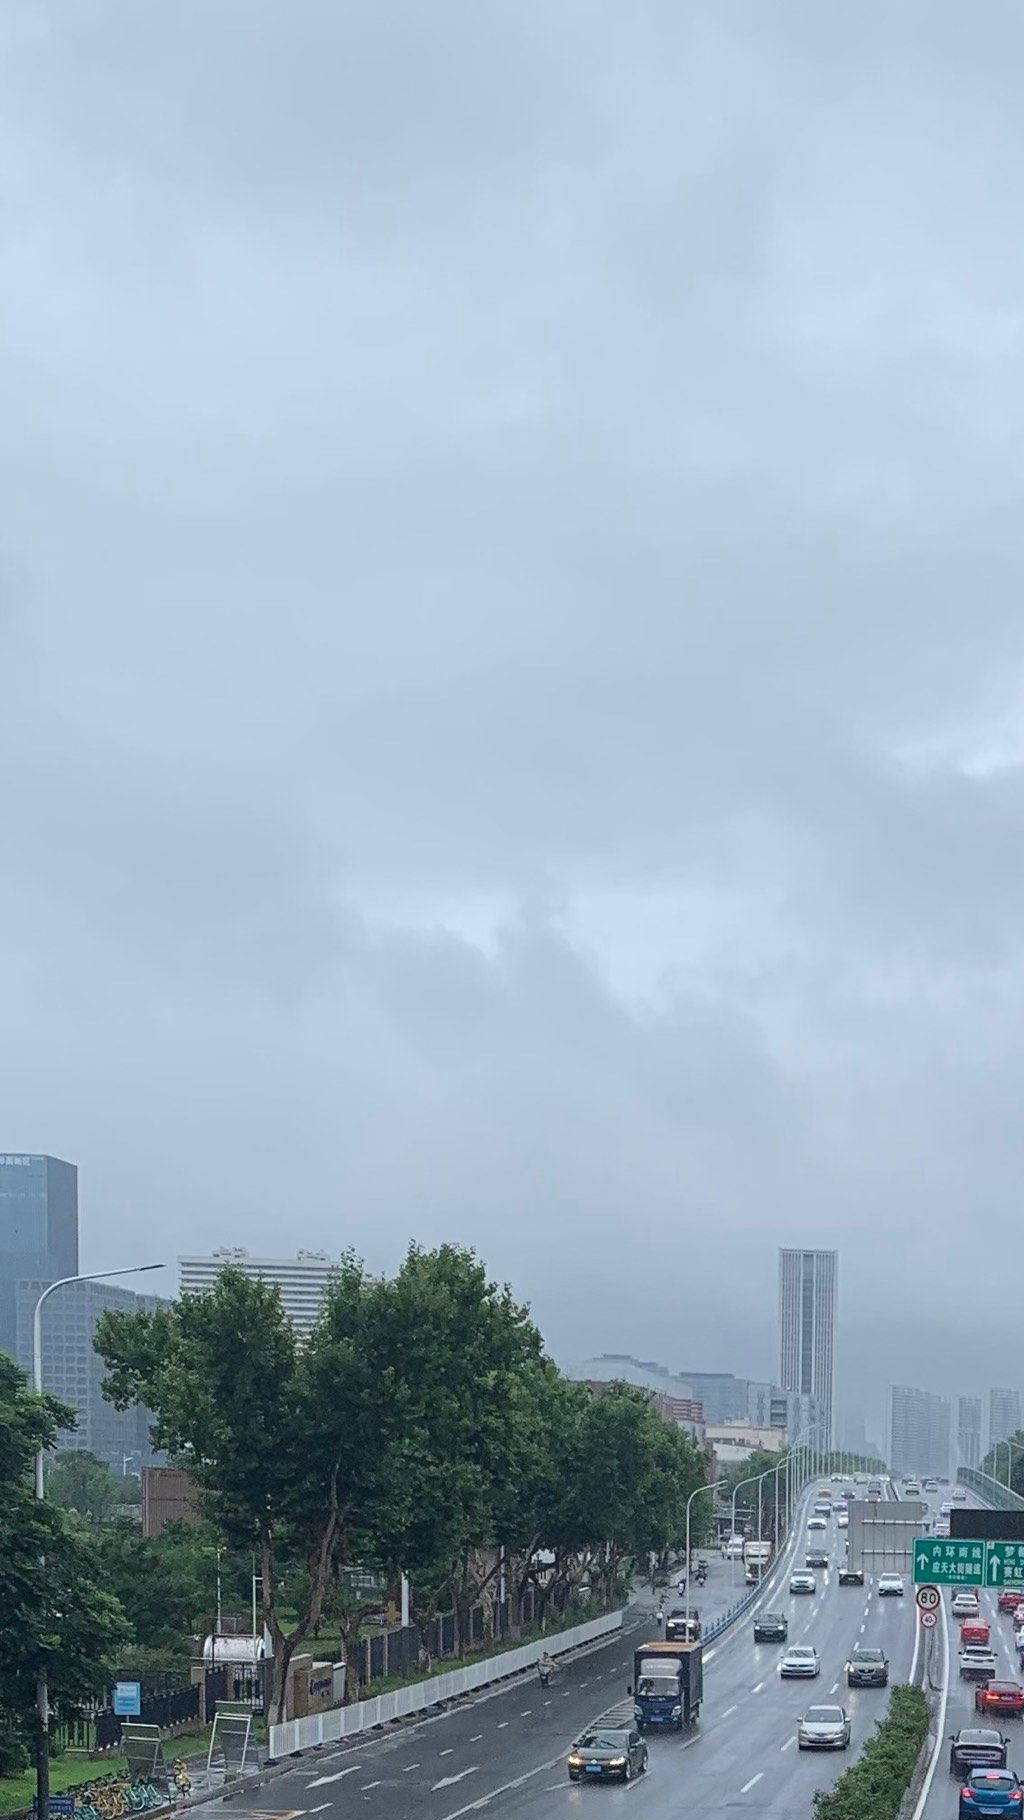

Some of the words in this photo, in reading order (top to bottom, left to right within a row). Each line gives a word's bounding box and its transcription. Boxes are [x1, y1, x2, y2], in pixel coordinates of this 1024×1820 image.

[932, 1545, 982, 1558] 内环南线
[921, 1592, 936, 1604] 80
